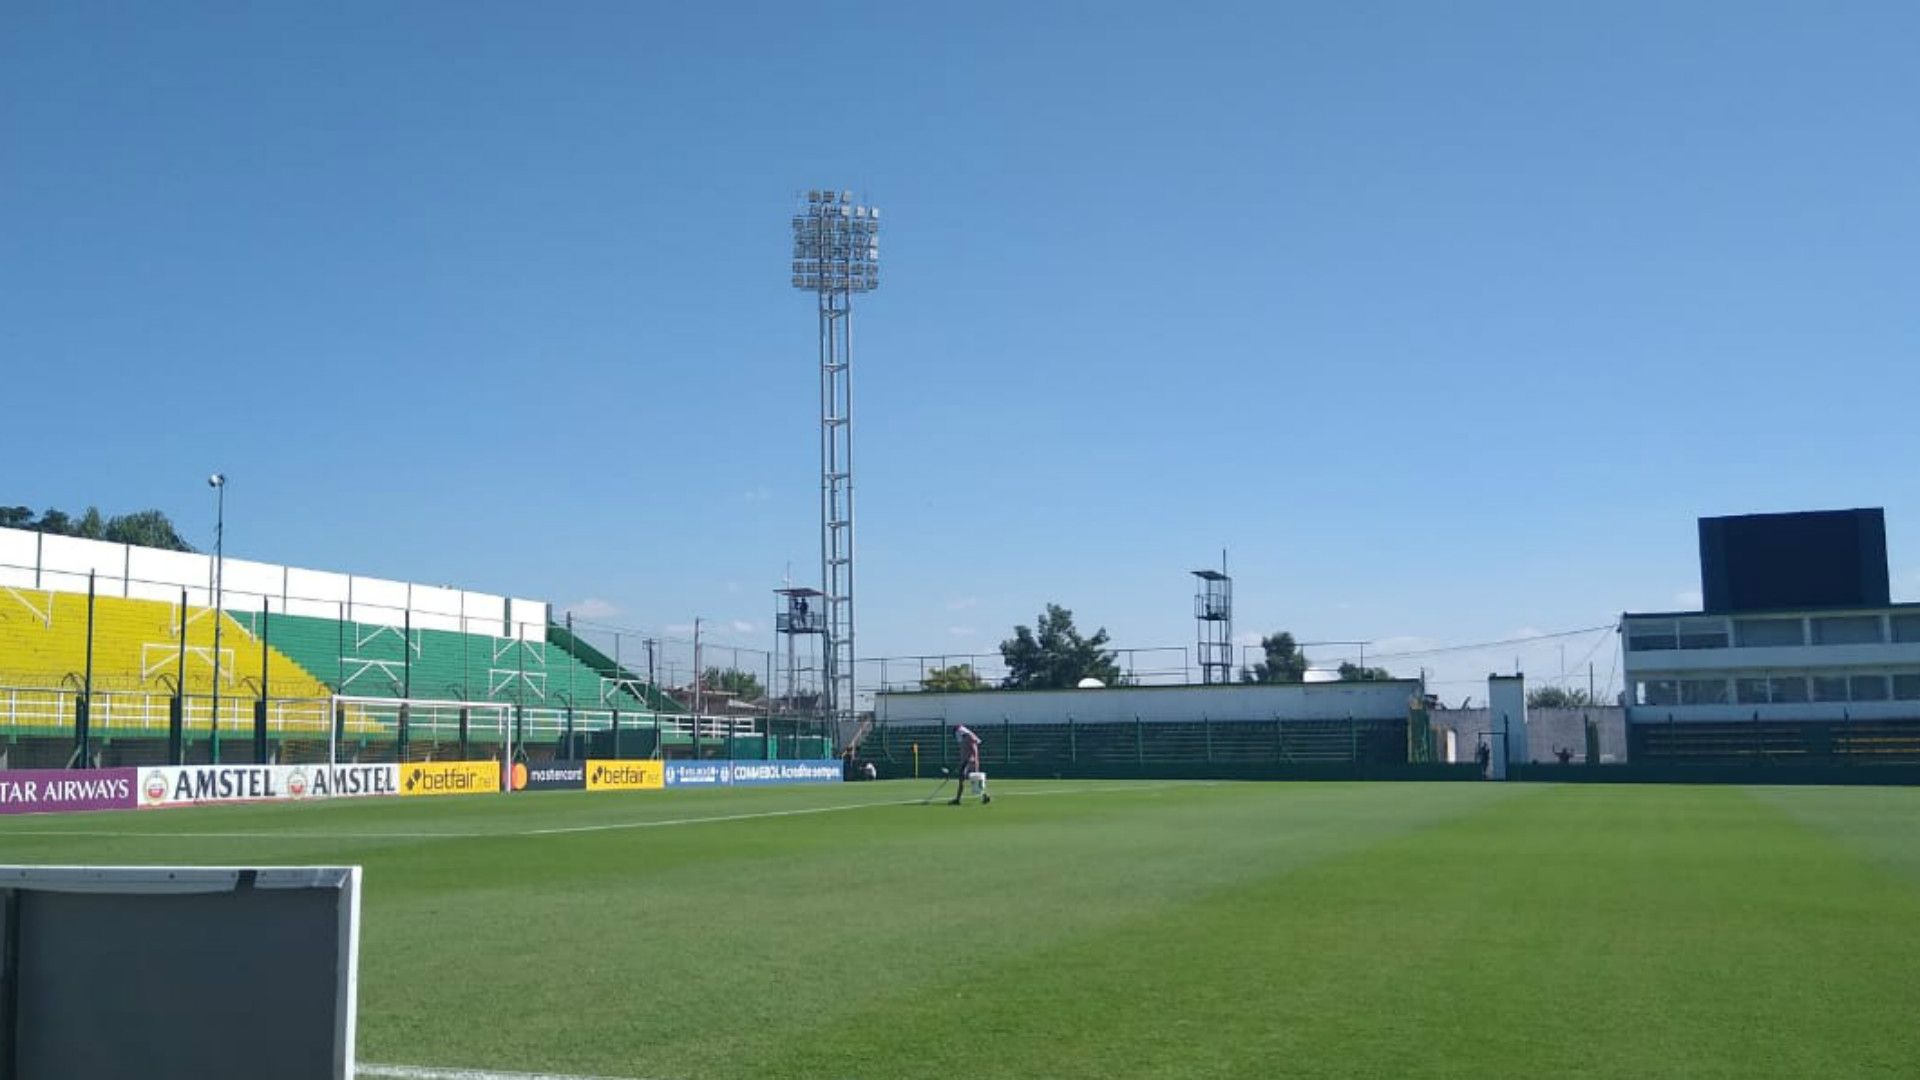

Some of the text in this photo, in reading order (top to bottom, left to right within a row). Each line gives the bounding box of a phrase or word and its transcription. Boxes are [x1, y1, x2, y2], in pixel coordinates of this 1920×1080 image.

[174, 769, 276, 799] AMSTEL
[312, 767, 395, 794] AMSTEL
[531, 768, 583, 782] mastercard
[43, 779, 129, 801] AIRWAYS
